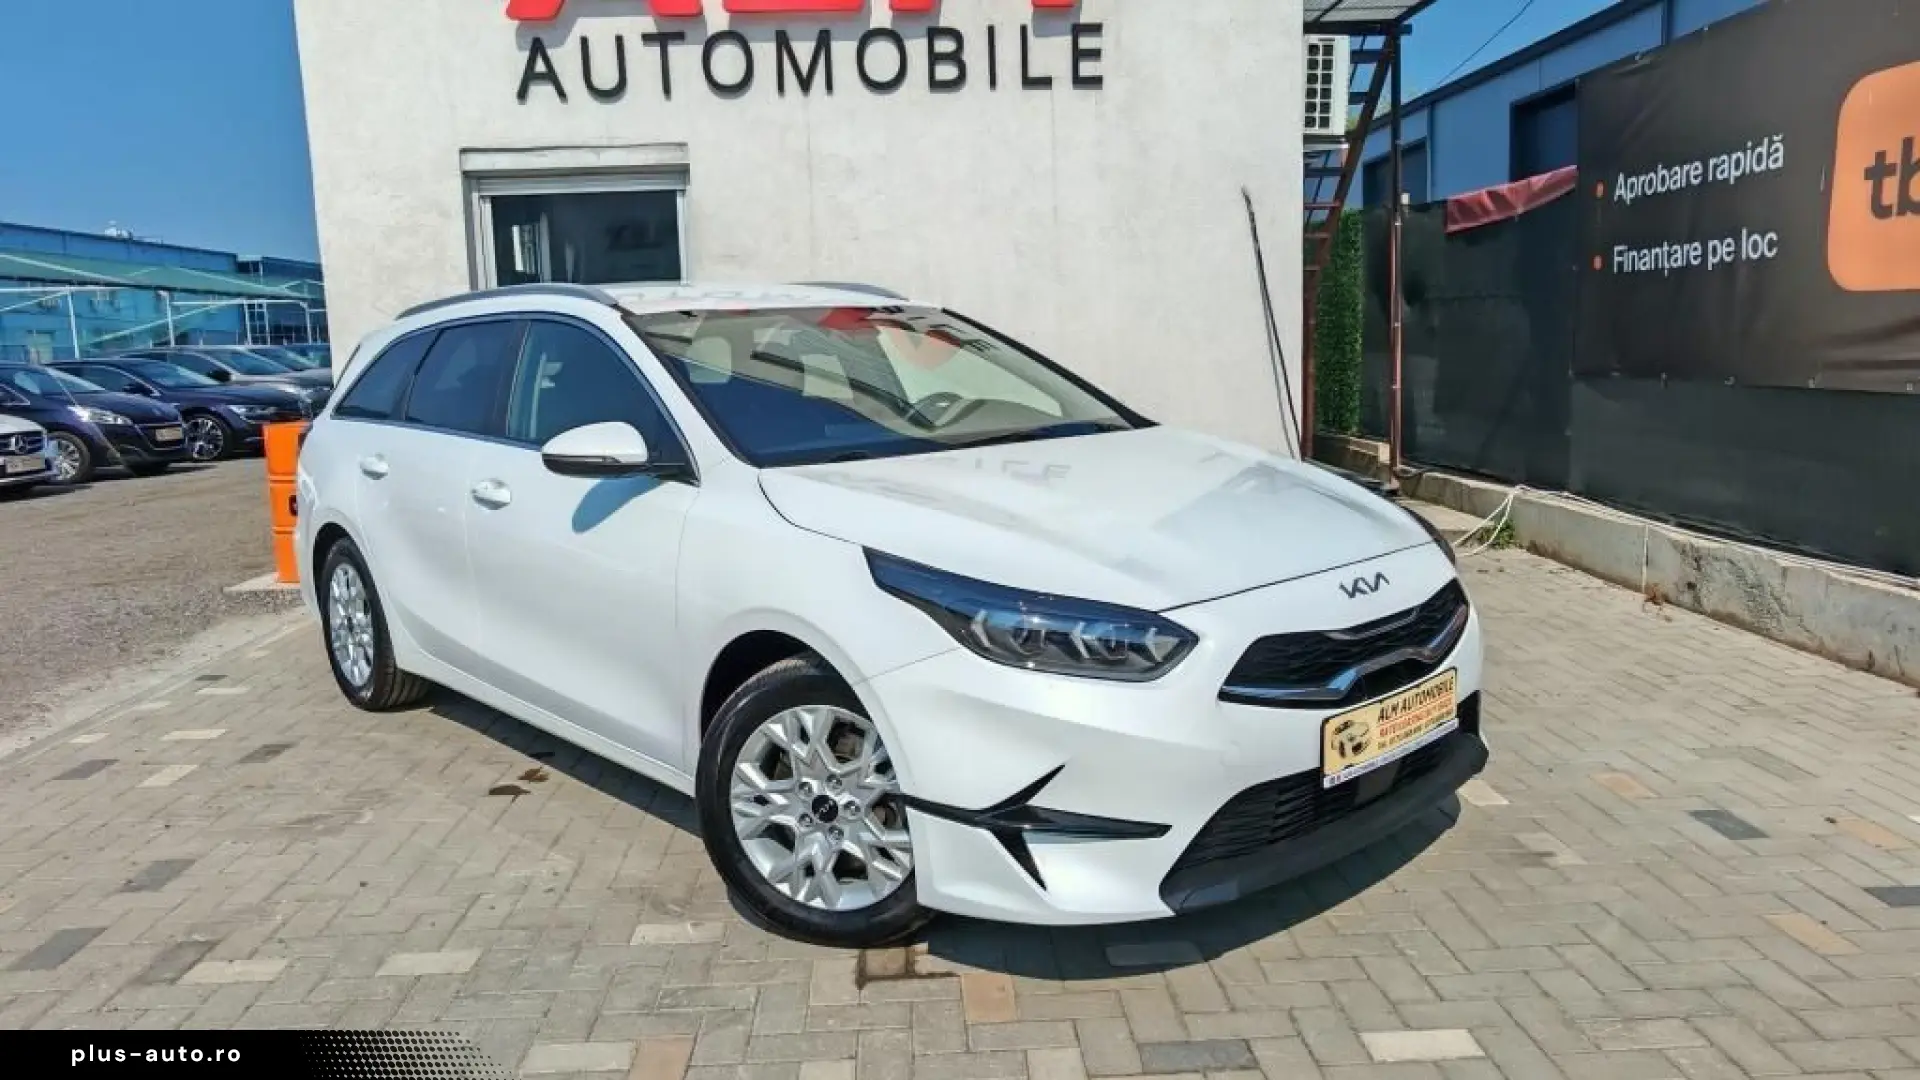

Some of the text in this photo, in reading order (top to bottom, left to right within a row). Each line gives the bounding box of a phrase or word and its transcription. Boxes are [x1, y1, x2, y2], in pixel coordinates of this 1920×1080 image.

[516, 23, 1104, 102] AUTOMOBILE
[1613, 133, 1785, 204] Aprobare rapidă
[1613, 226, 1778, 276] Finanțare pe loc
